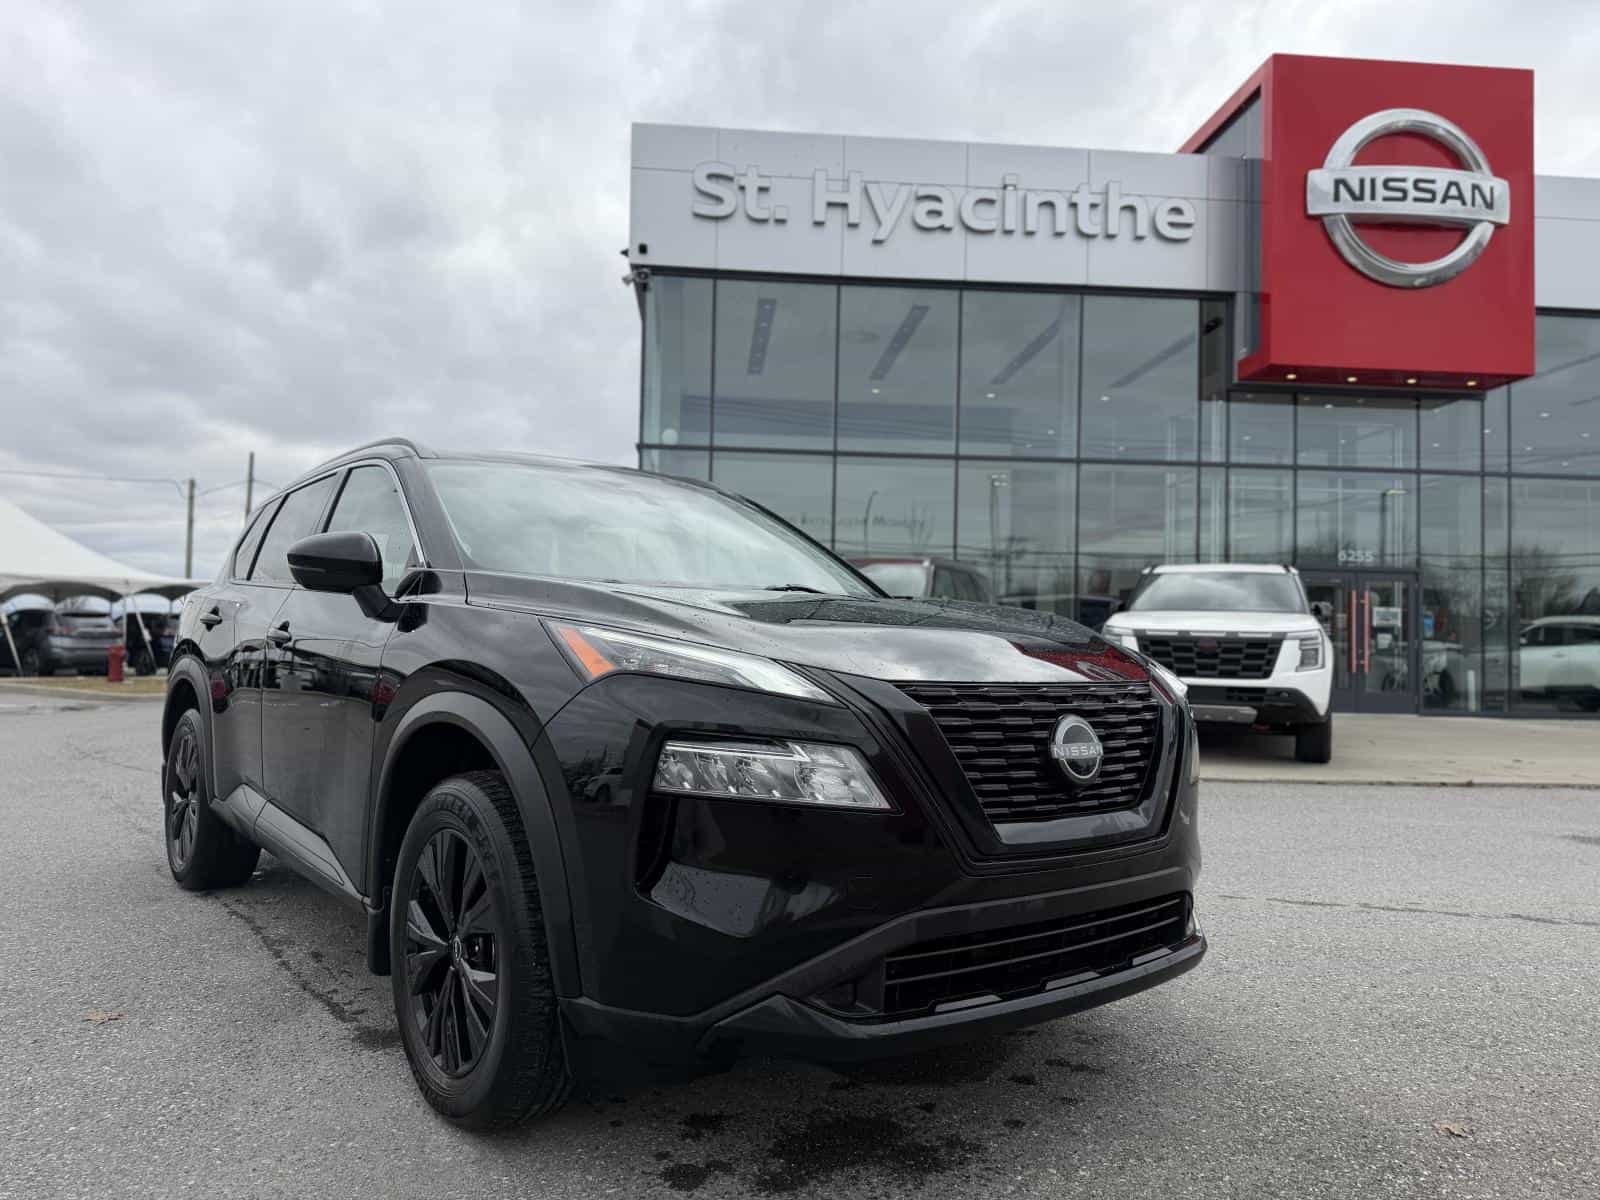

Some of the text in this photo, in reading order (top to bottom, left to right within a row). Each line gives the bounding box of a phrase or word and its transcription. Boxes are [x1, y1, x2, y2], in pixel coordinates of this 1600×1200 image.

[691, 161, 1196, 244] St. Hyacinthe
[1333, 177, 1495, 211] NISSAN
[1053, 745, 1103, 758] NISSAN
